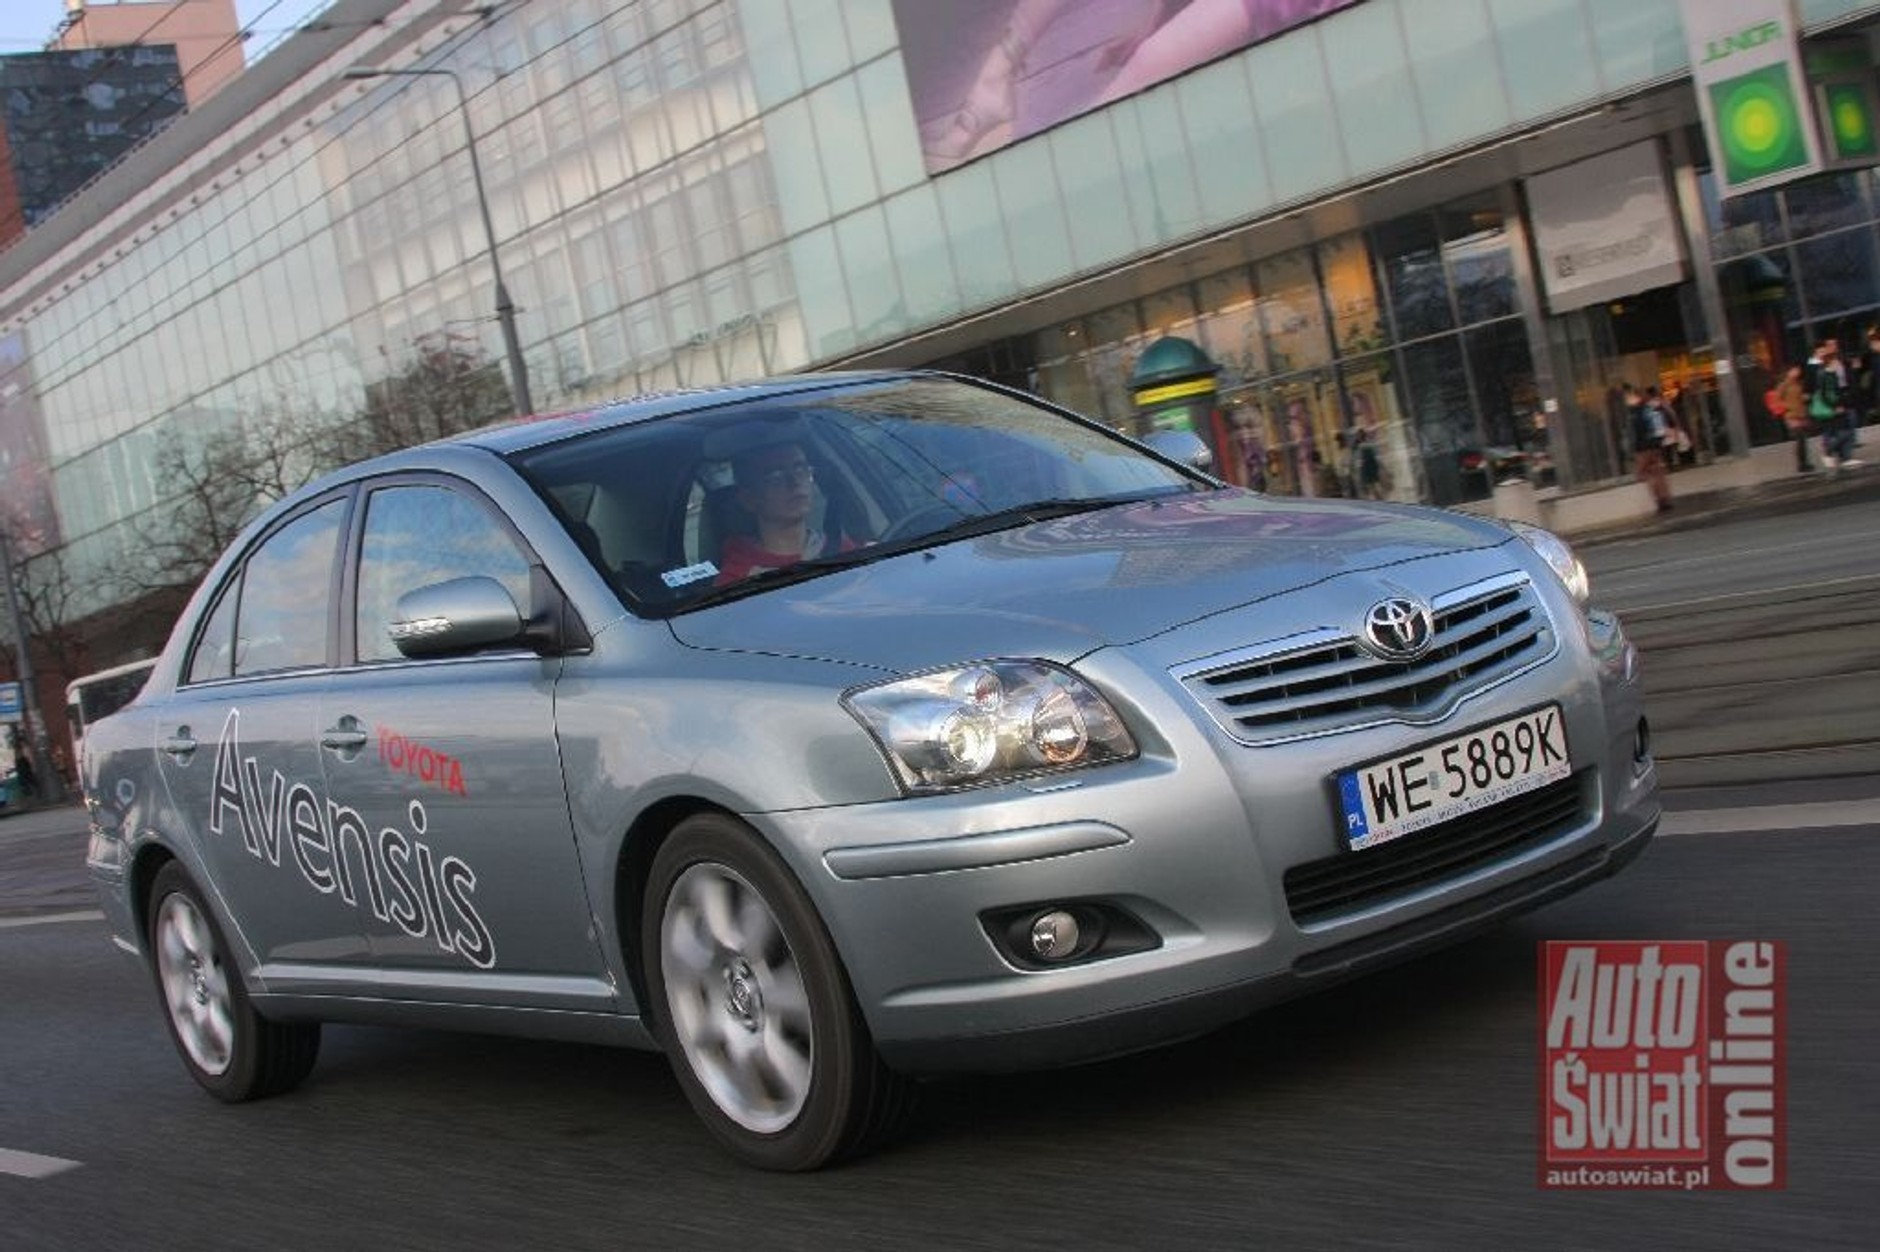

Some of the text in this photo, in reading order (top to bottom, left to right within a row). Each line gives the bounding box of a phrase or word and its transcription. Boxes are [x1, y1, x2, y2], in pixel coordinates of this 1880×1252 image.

[374, 722, 468, 798] TOYOTA
[1367, 756, 1432, 824] WE
[1441, 711, 1563, 799] 5889K
[210, 706, 496, 969] Avensis
[1347, 812, 1364, 830] PL
